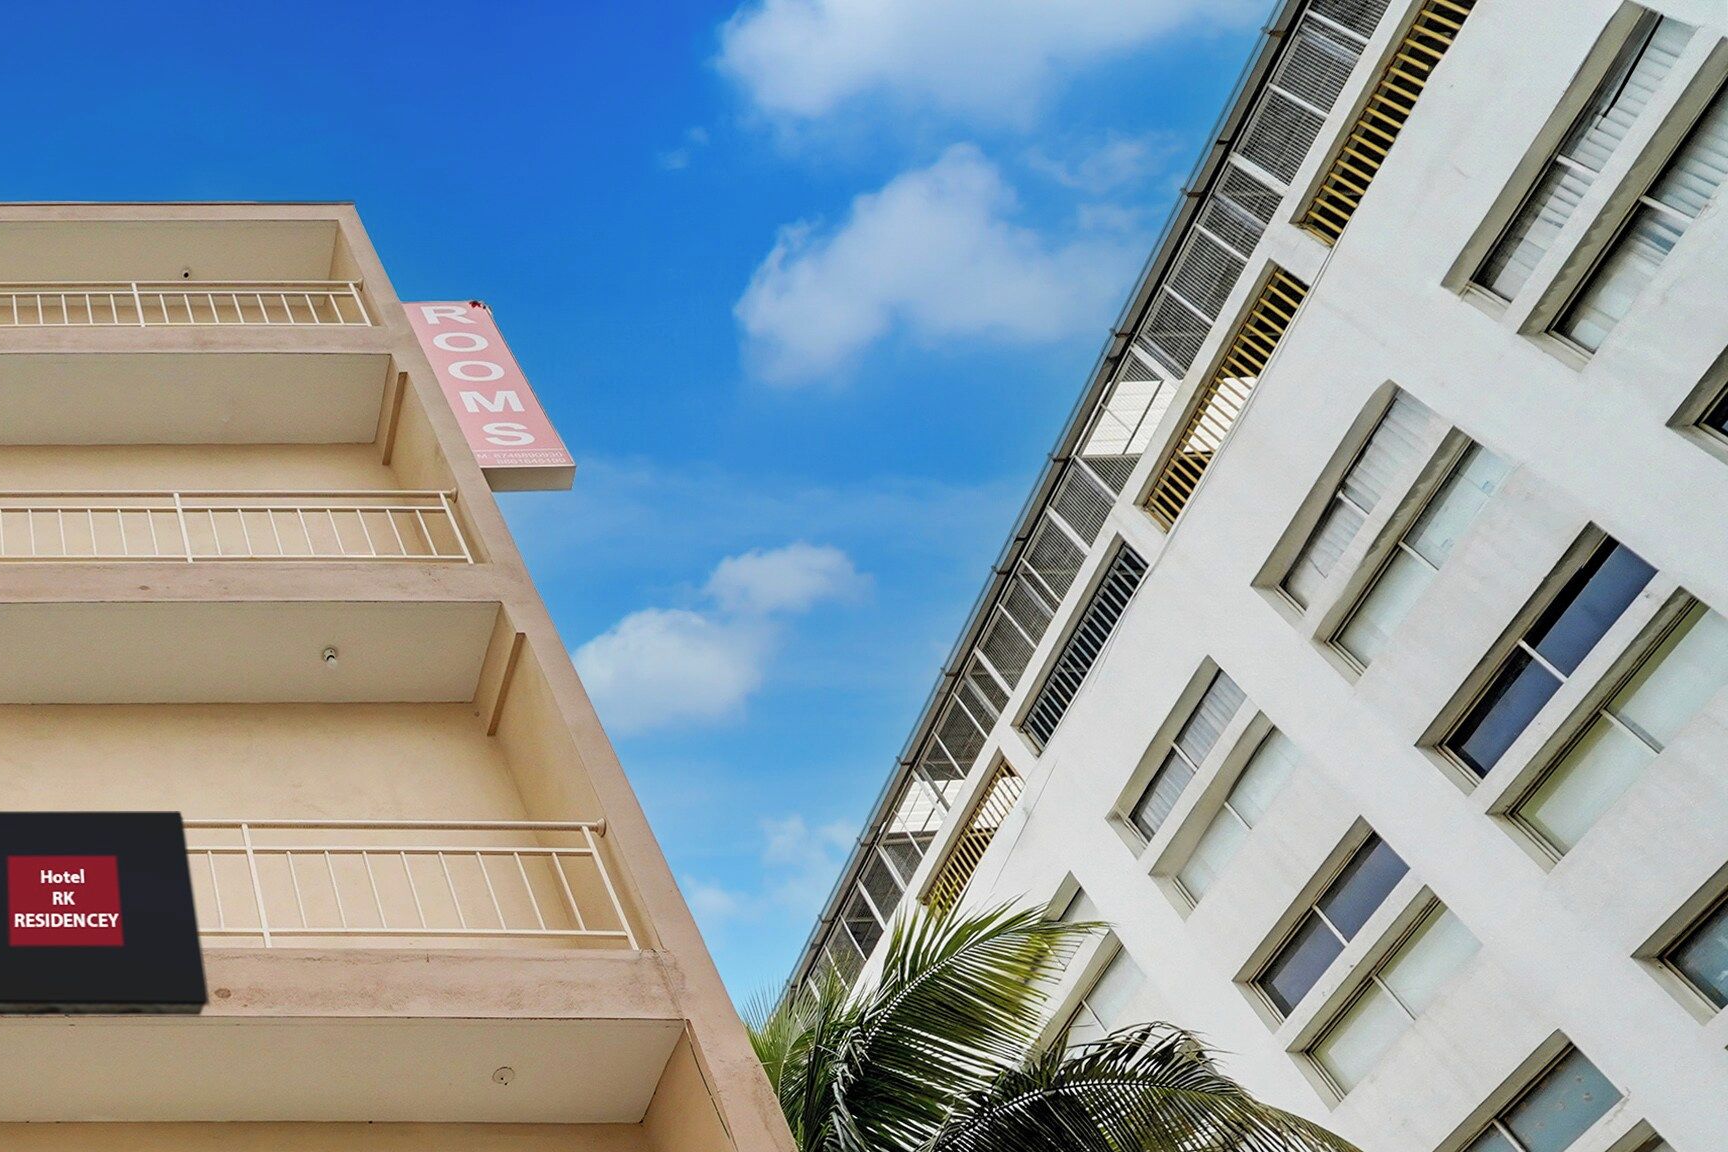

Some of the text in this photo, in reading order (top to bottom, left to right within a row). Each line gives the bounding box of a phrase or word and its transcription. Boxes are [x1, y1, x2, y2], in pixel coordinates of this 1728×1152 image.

[420, 305, 535, 446] ROOMS
[40, 868, 86, 884] Hotel
[52, 891, 76, 906] RK
[14, 912, 119, 928] RESIDENCEY
